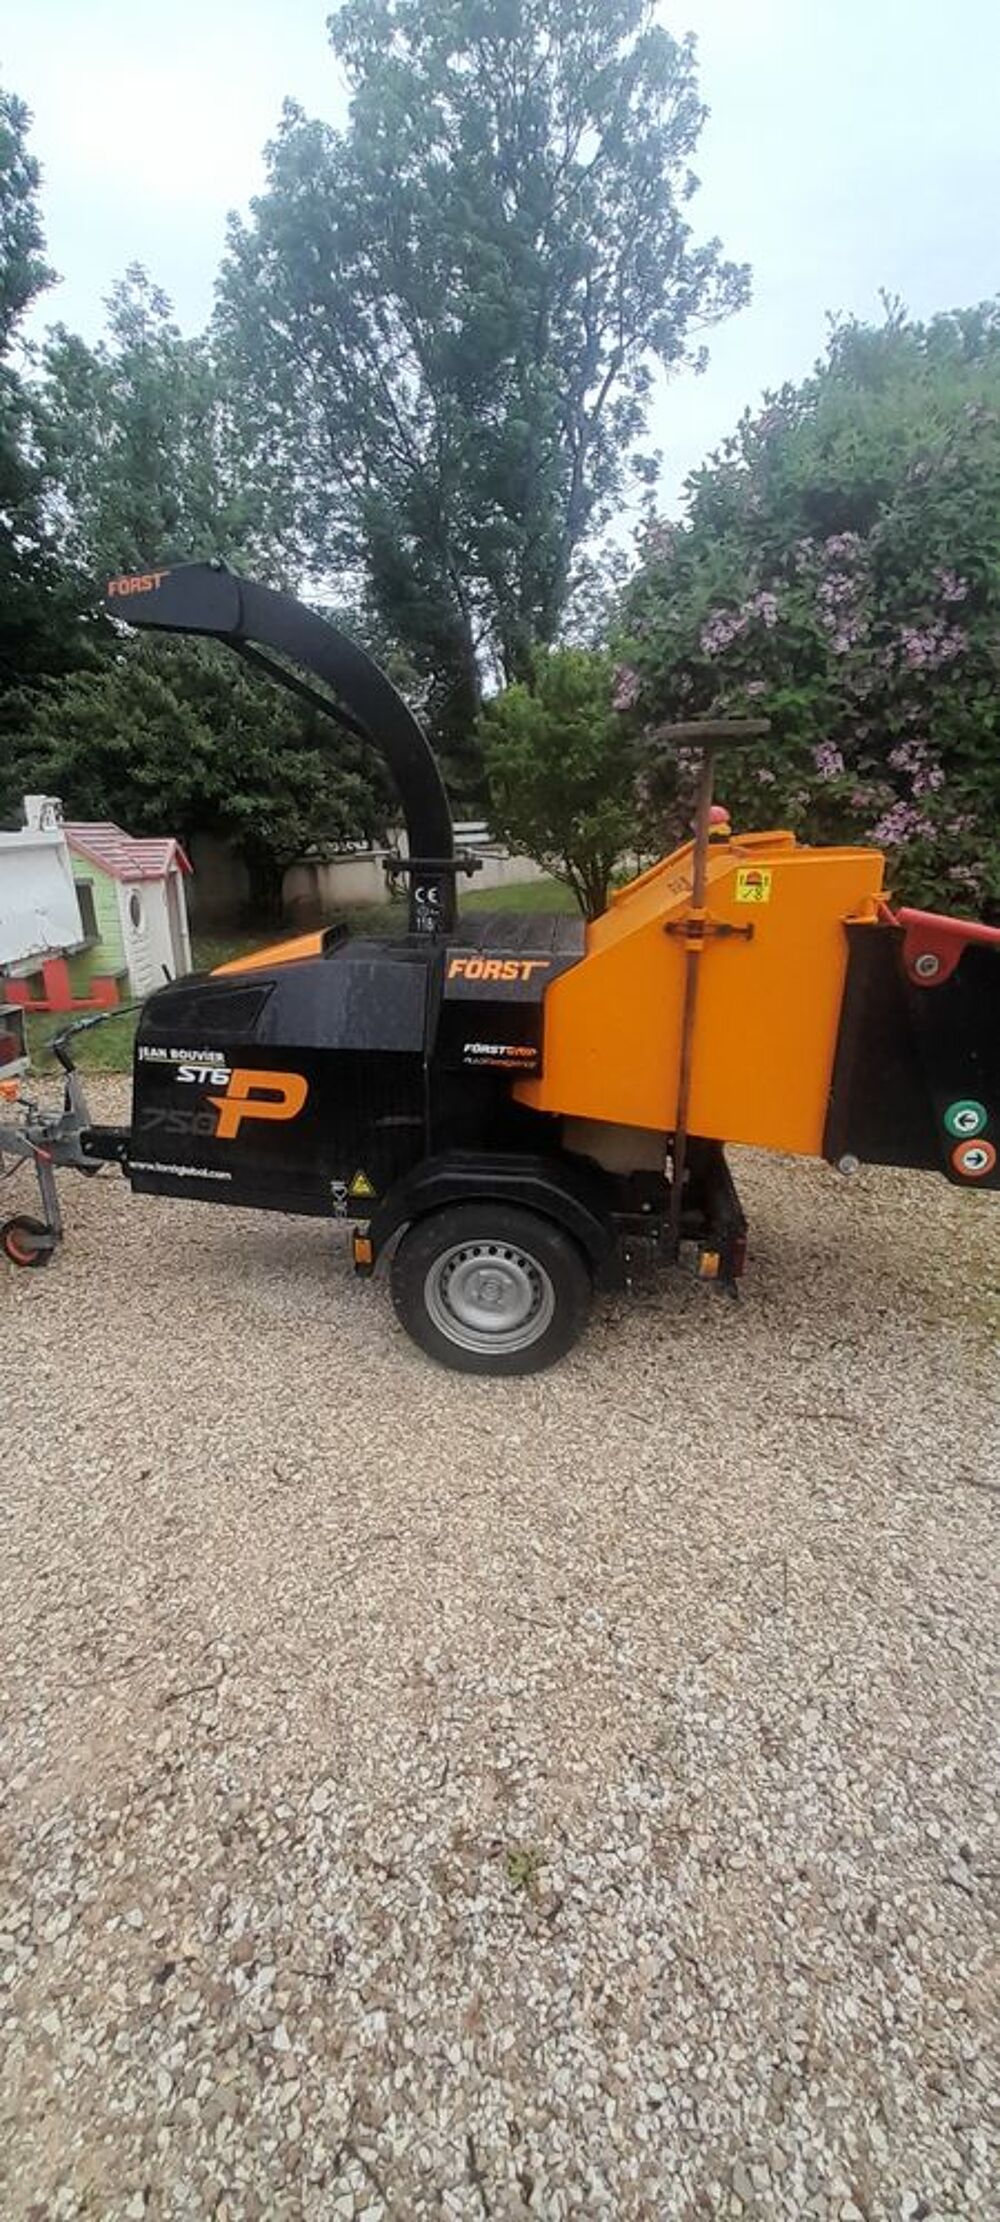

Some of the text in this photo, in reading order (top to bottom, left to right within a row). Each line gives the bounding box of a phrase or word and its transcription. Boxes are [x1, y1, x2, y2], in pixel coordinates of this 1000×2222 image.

[415, 886, 438, 903] CE
[447, 955, 550, 981] FÖRST
[138, 1046, 225, 1063] JEAN BOUVIER
